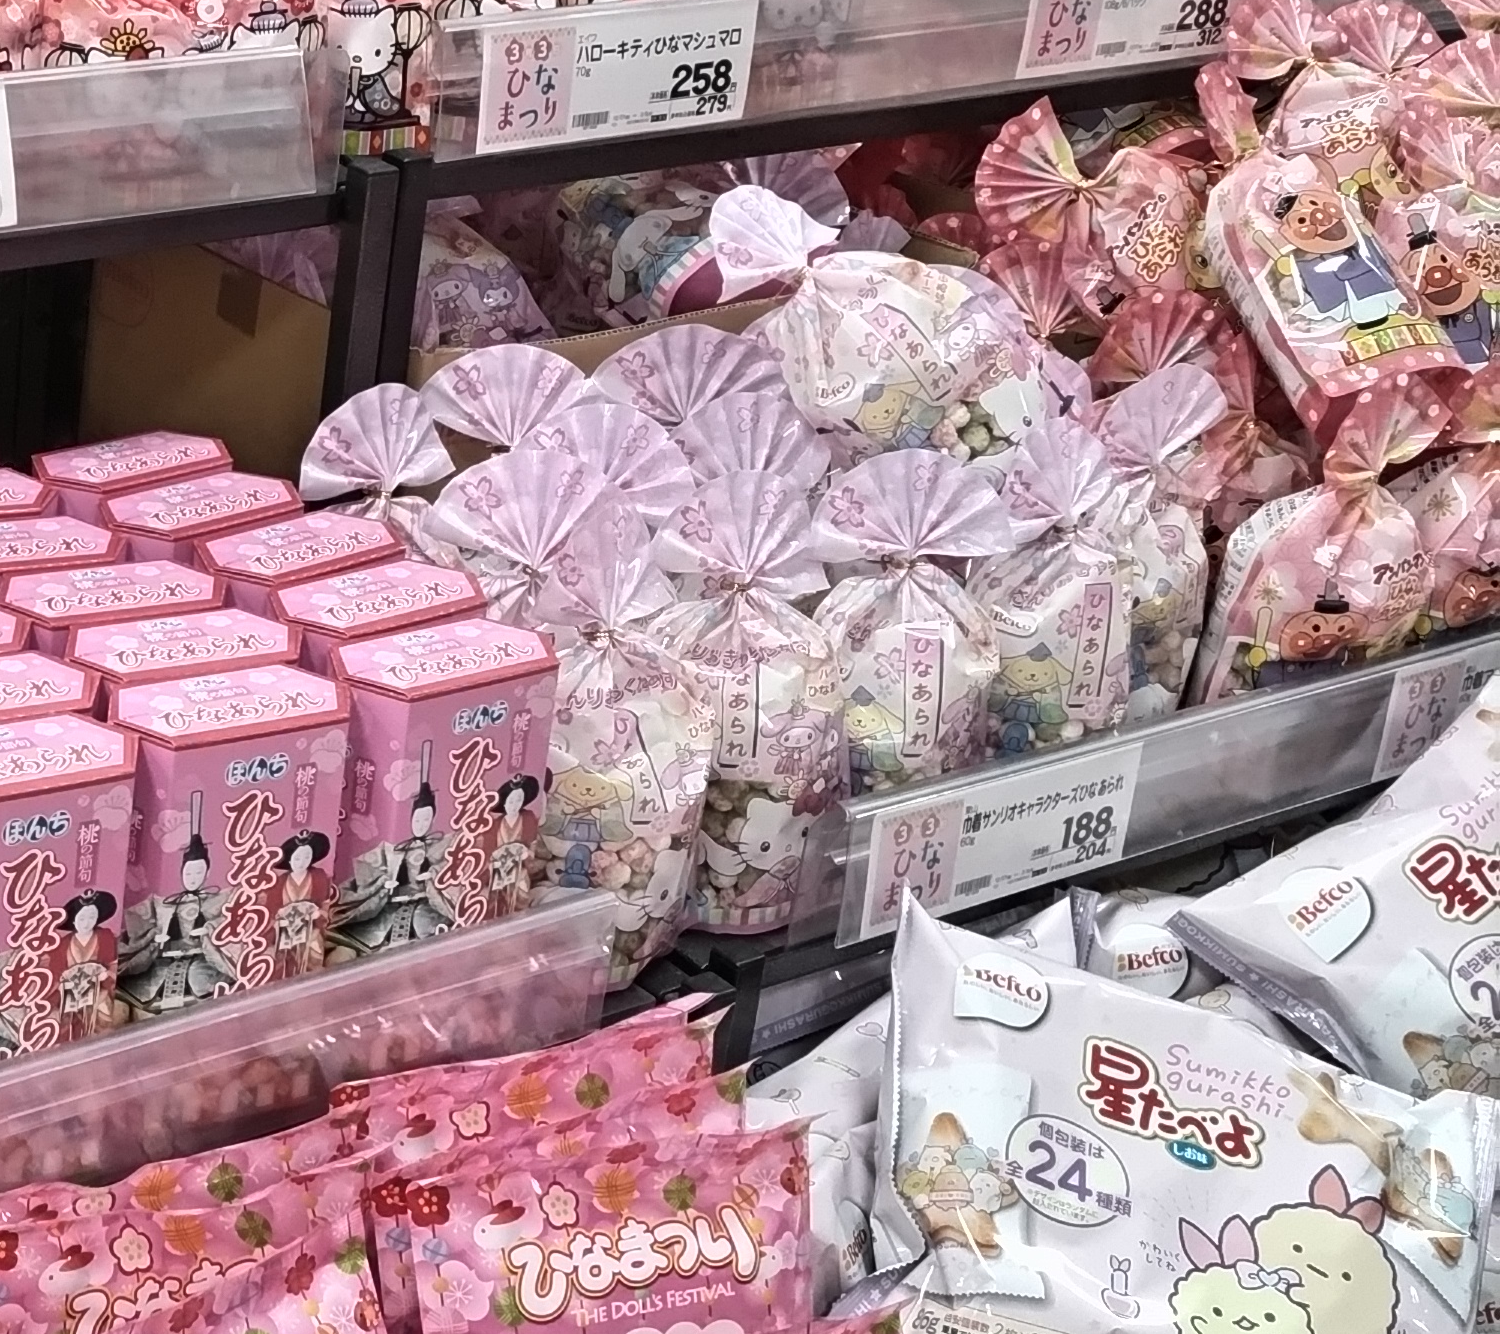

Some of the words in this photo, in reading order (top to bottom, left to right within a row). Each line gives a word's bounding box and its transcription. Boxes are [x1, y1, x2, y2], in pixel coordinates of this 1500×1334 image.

[577, 27, 742, 64] ハローキティひなマシュマロ
[1073, 591, 1107, 698] ひなあられ
[909, 636, 934, 749] ひなあられ
[451, 701, 510, 735] ほんち
[224, 752, 292, 789] ほんち
[295, 762, 319, 826] 桃の節句
[1, 810, 71, 848] ほんち
[77, 820, 102, 884] 桃の節句
[1294, 878, 1355, 927] Befco
[1126, 945, 1184, 972] Befco
[1166, 1043, 1292, 1099] Sumikko
[1166, 1071, 1286, 1118] gurashi
[1086, 1041, 1263, 1165] 星たべよ
[1038, 1120, 1105, 1160] 個包装は
[1172, 1144, 1211, 1167] しお味
[511, 1205, 759, 1321] ひなまつり
[1139, 1238, 1182, 1263] かわいく
[1143, 1251, 1178, 1273] してね
[570, 1305, 609, 1329] THE
[666, 1280, 737, 1315] FESTIVAL
